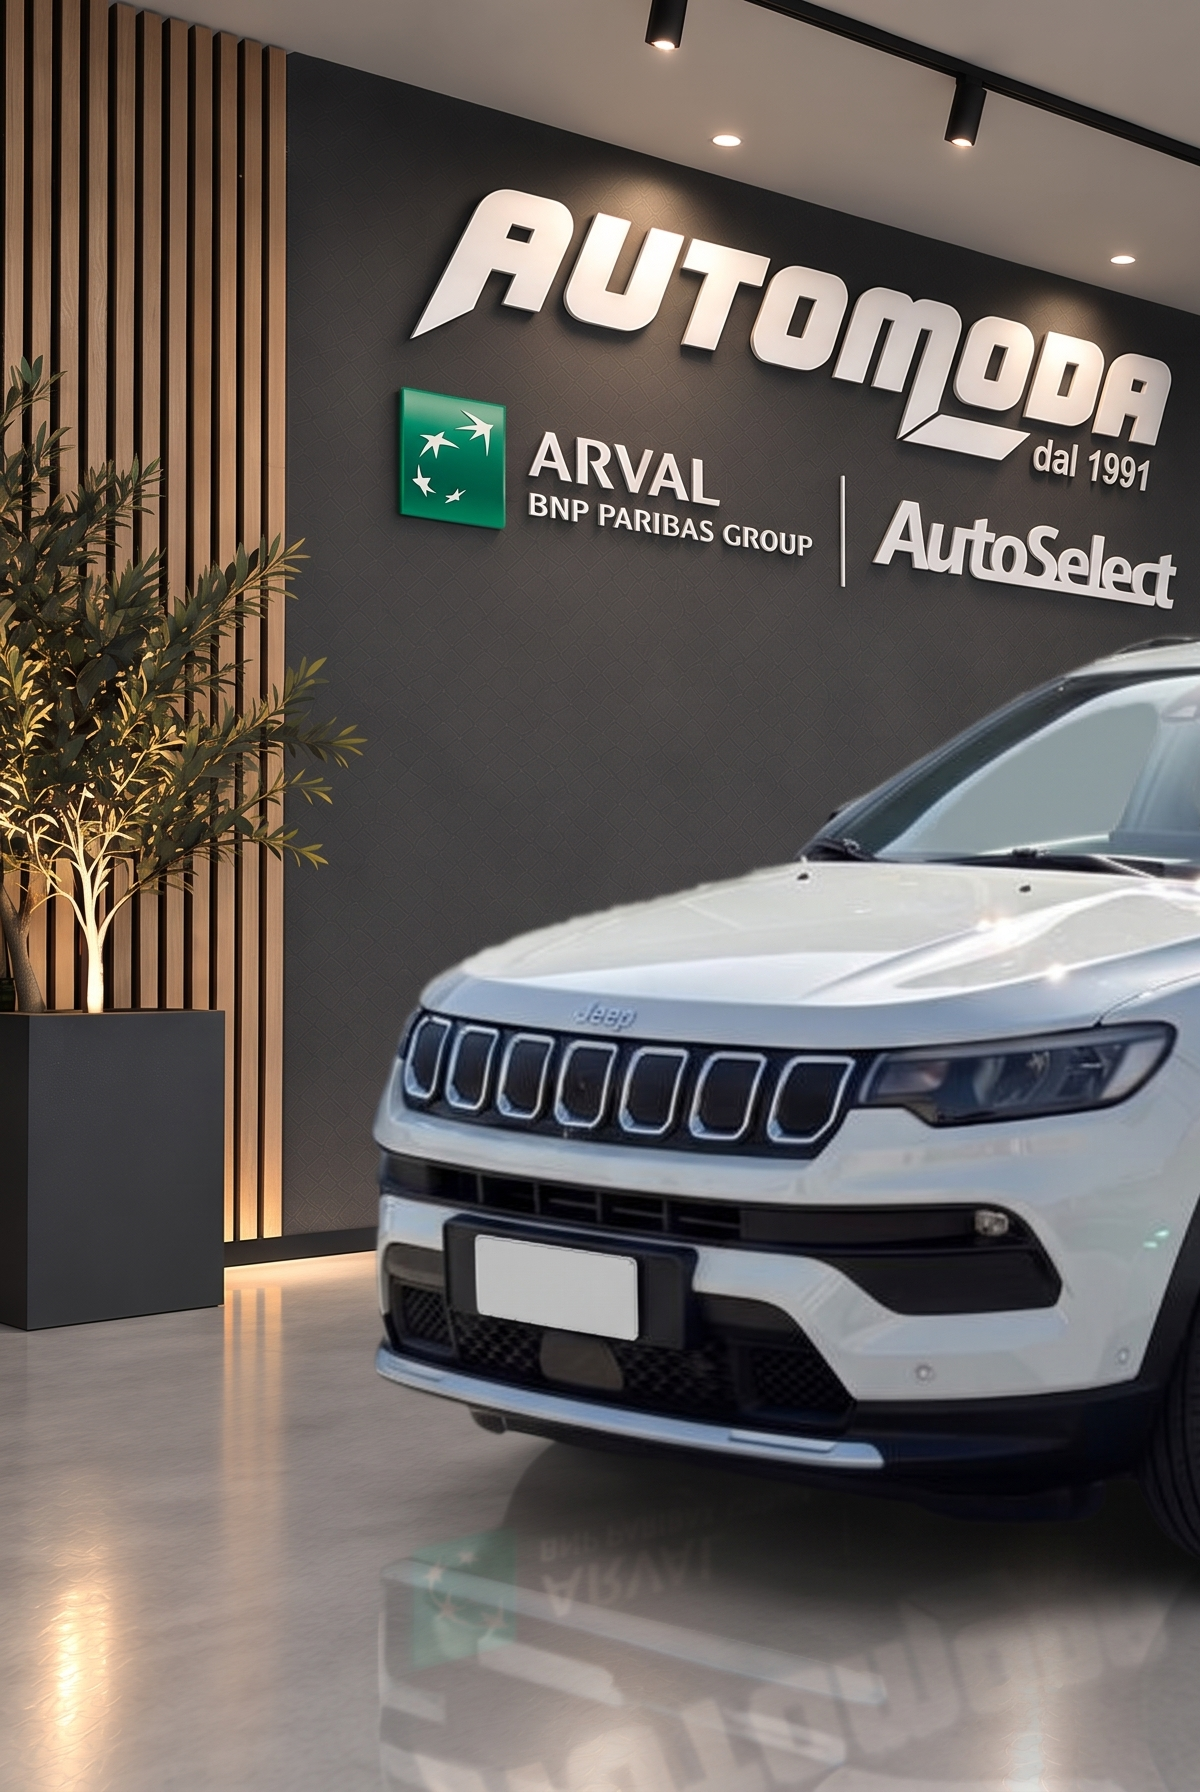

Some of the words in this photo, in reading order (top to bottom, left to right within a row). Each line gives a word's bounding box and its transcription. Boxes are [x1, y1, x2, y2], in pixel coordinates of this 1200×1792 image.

[410, 188, 1172, 460] AUTOMODA
[528, 431, 721, 507] ARVAL
[1033, 439, 1079, 478] dal
[1088, 449, 1150, 492] 1991
[528, 492, 590, 523] BNP
[598, 503, 714, 543] PARIBAS
[722, 524, 813, 557] GROUP
[872, 499, 1177, 609] AutoSelect
[572, 1002, 637, 1031] Jeep
